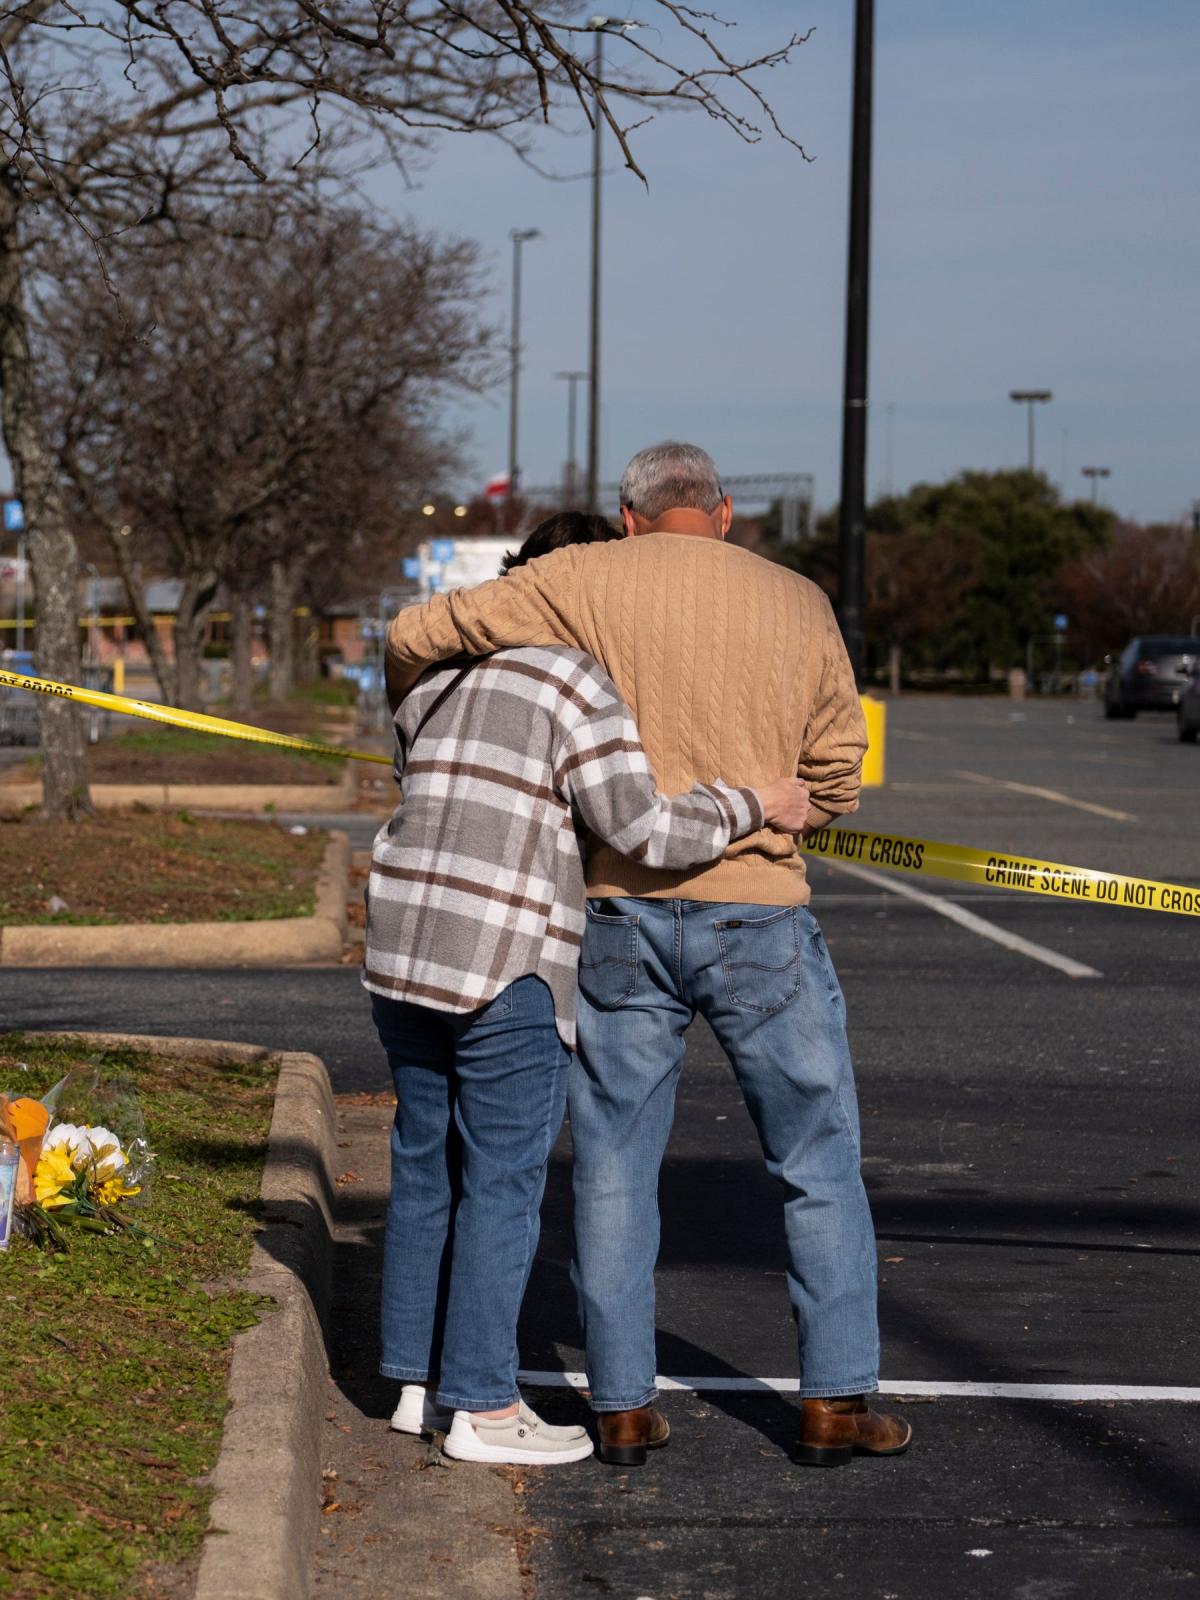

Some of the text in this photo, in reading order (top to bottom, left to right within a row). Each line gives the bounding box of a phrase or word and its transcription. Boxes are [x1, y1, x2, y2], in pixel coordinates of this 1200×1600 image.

[806, 828, 925, 869] DO NOT CROSS
[985, 857, 1200, 913] CRIME SCENE DO NOT CROS
